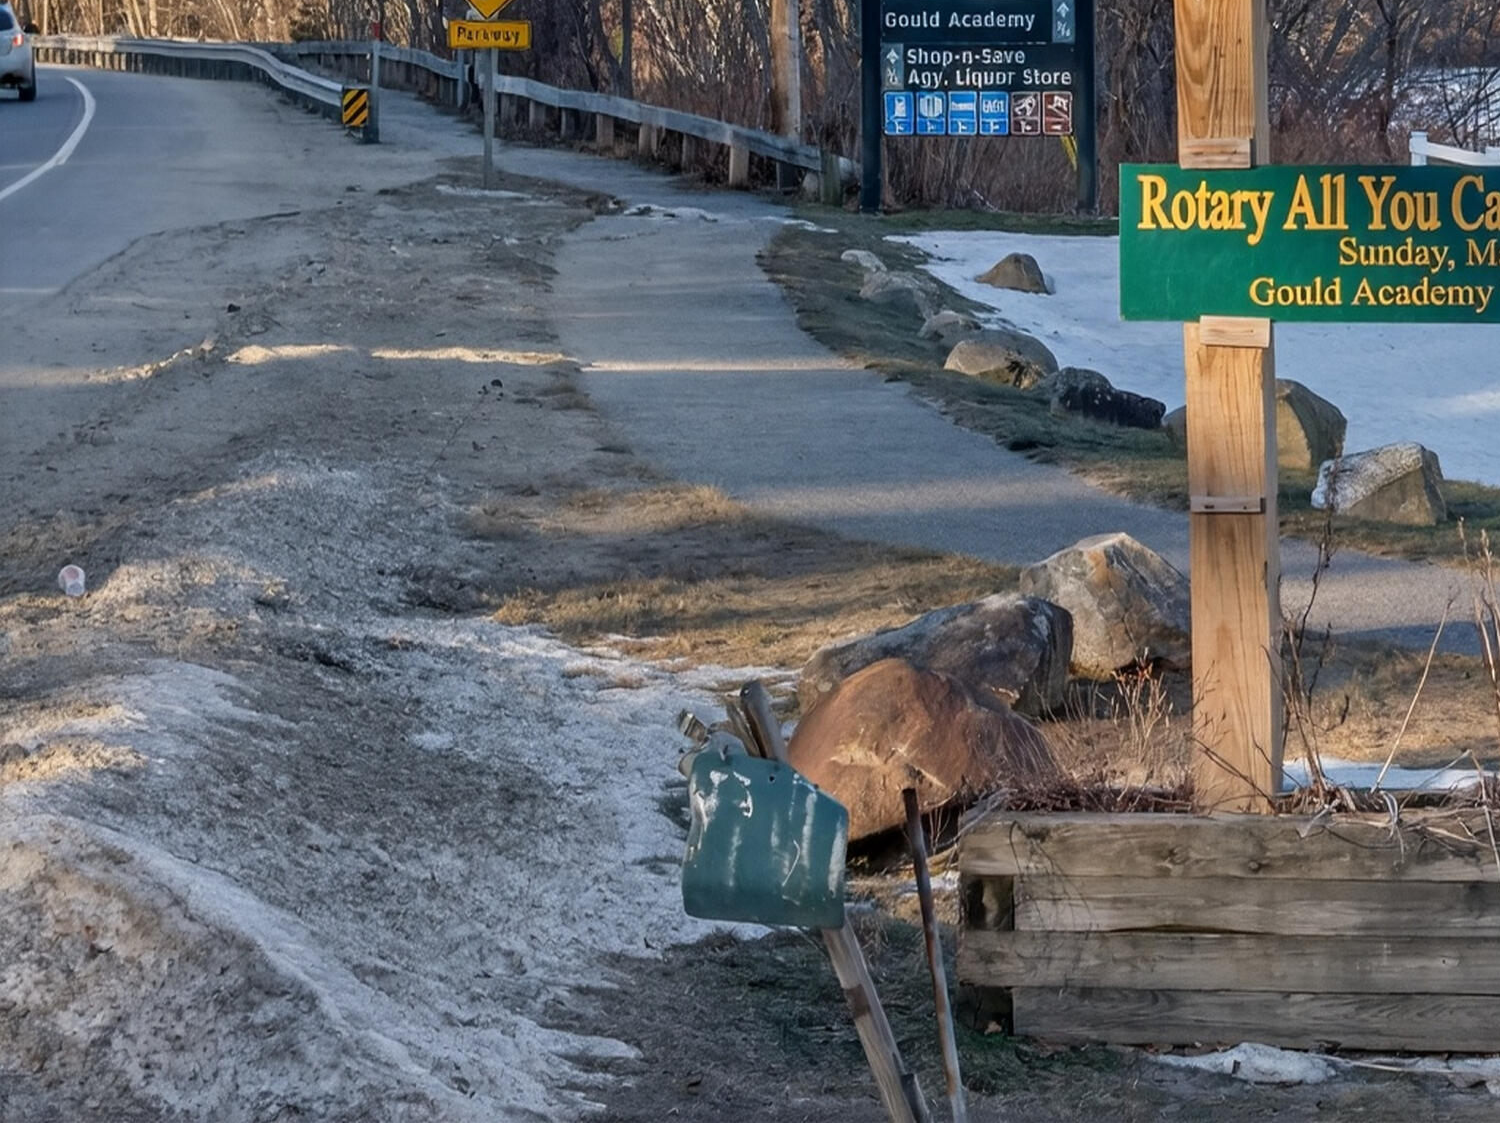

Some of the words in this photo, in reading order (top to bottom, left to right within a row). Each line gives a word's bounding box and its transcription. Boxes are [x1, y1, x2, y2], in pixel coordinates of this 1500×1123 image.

[885, 11, 940, 27] Gould
[949, 11, 1035, 31] Academy
[907, 48, 1026, 66] Shop-n-Save
[956, 68, 1015, 88] Liquor
[1023, 69, 1072, 86] Store
[1137, 174, 1273, 245] Rotary
[1283, 174, 1347, 231] All
[1358, 175, 1442, 231] You
[1338, 237, 1455, 273] Sunday,
[1249, 276, 1342, 307] Gould
[1351, 278, 1495, 315] Academy
